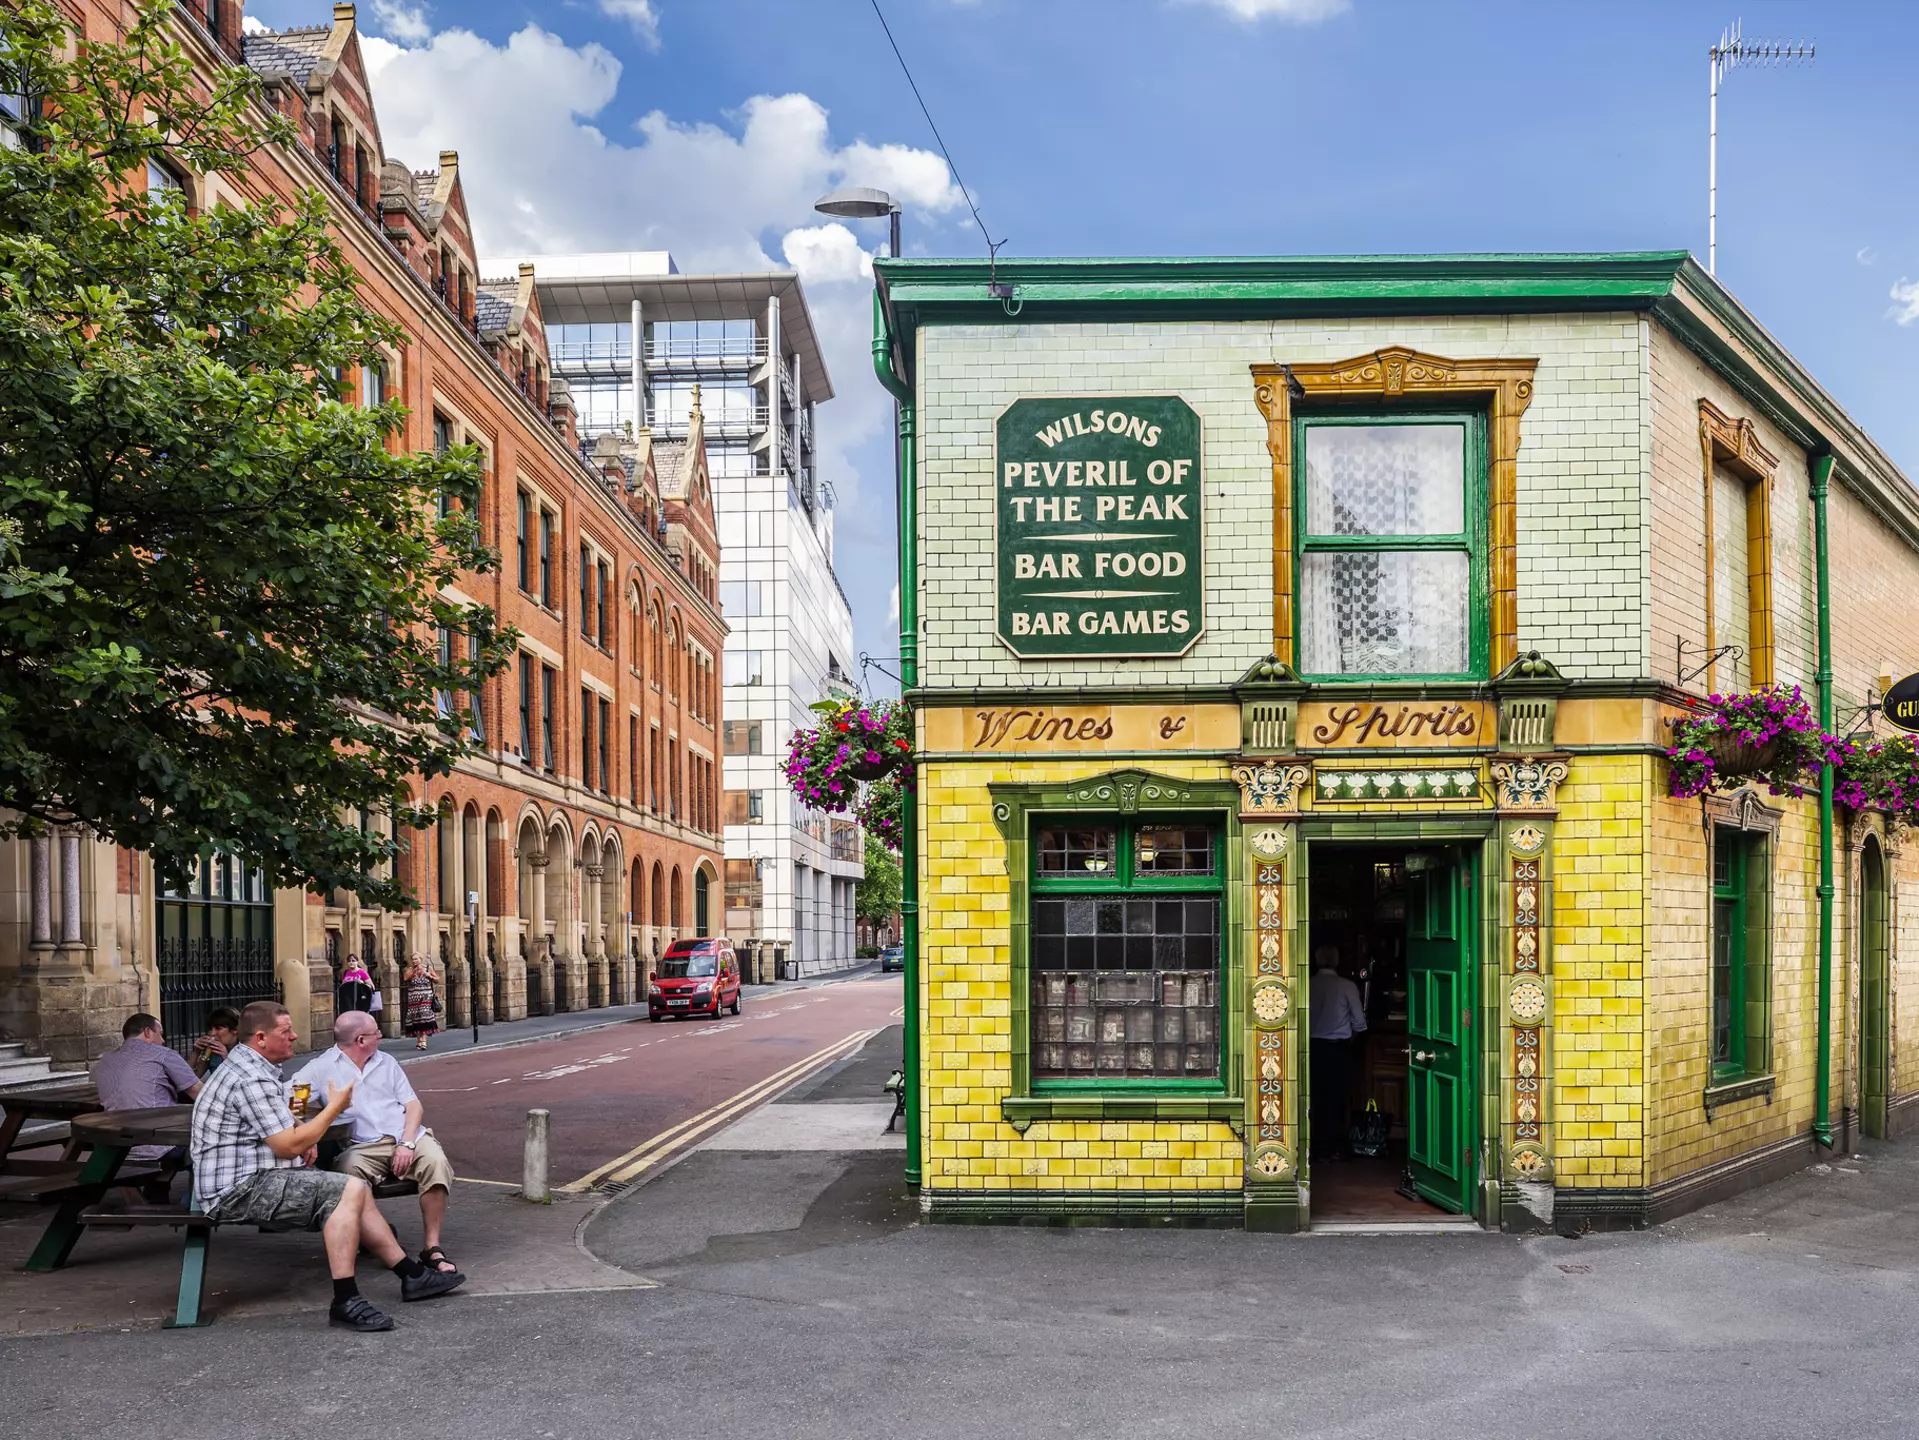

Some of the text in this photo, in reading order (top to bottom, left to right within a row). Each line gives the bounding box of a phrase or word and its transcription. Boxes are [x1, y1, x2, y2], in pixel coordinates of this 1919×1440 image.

[1036, 410, 1162, 448] WILSONS
[1005, 459, 1192, 488] PEVERIL OF
[1010, 495, 1189, 523] THE PEAK
[1015, 552, 1187, 578] BAR FOOD
[1012, 610, 1190, 635] BAR GAMES
[974, 704, 1475, 748] Wines & Spirits
